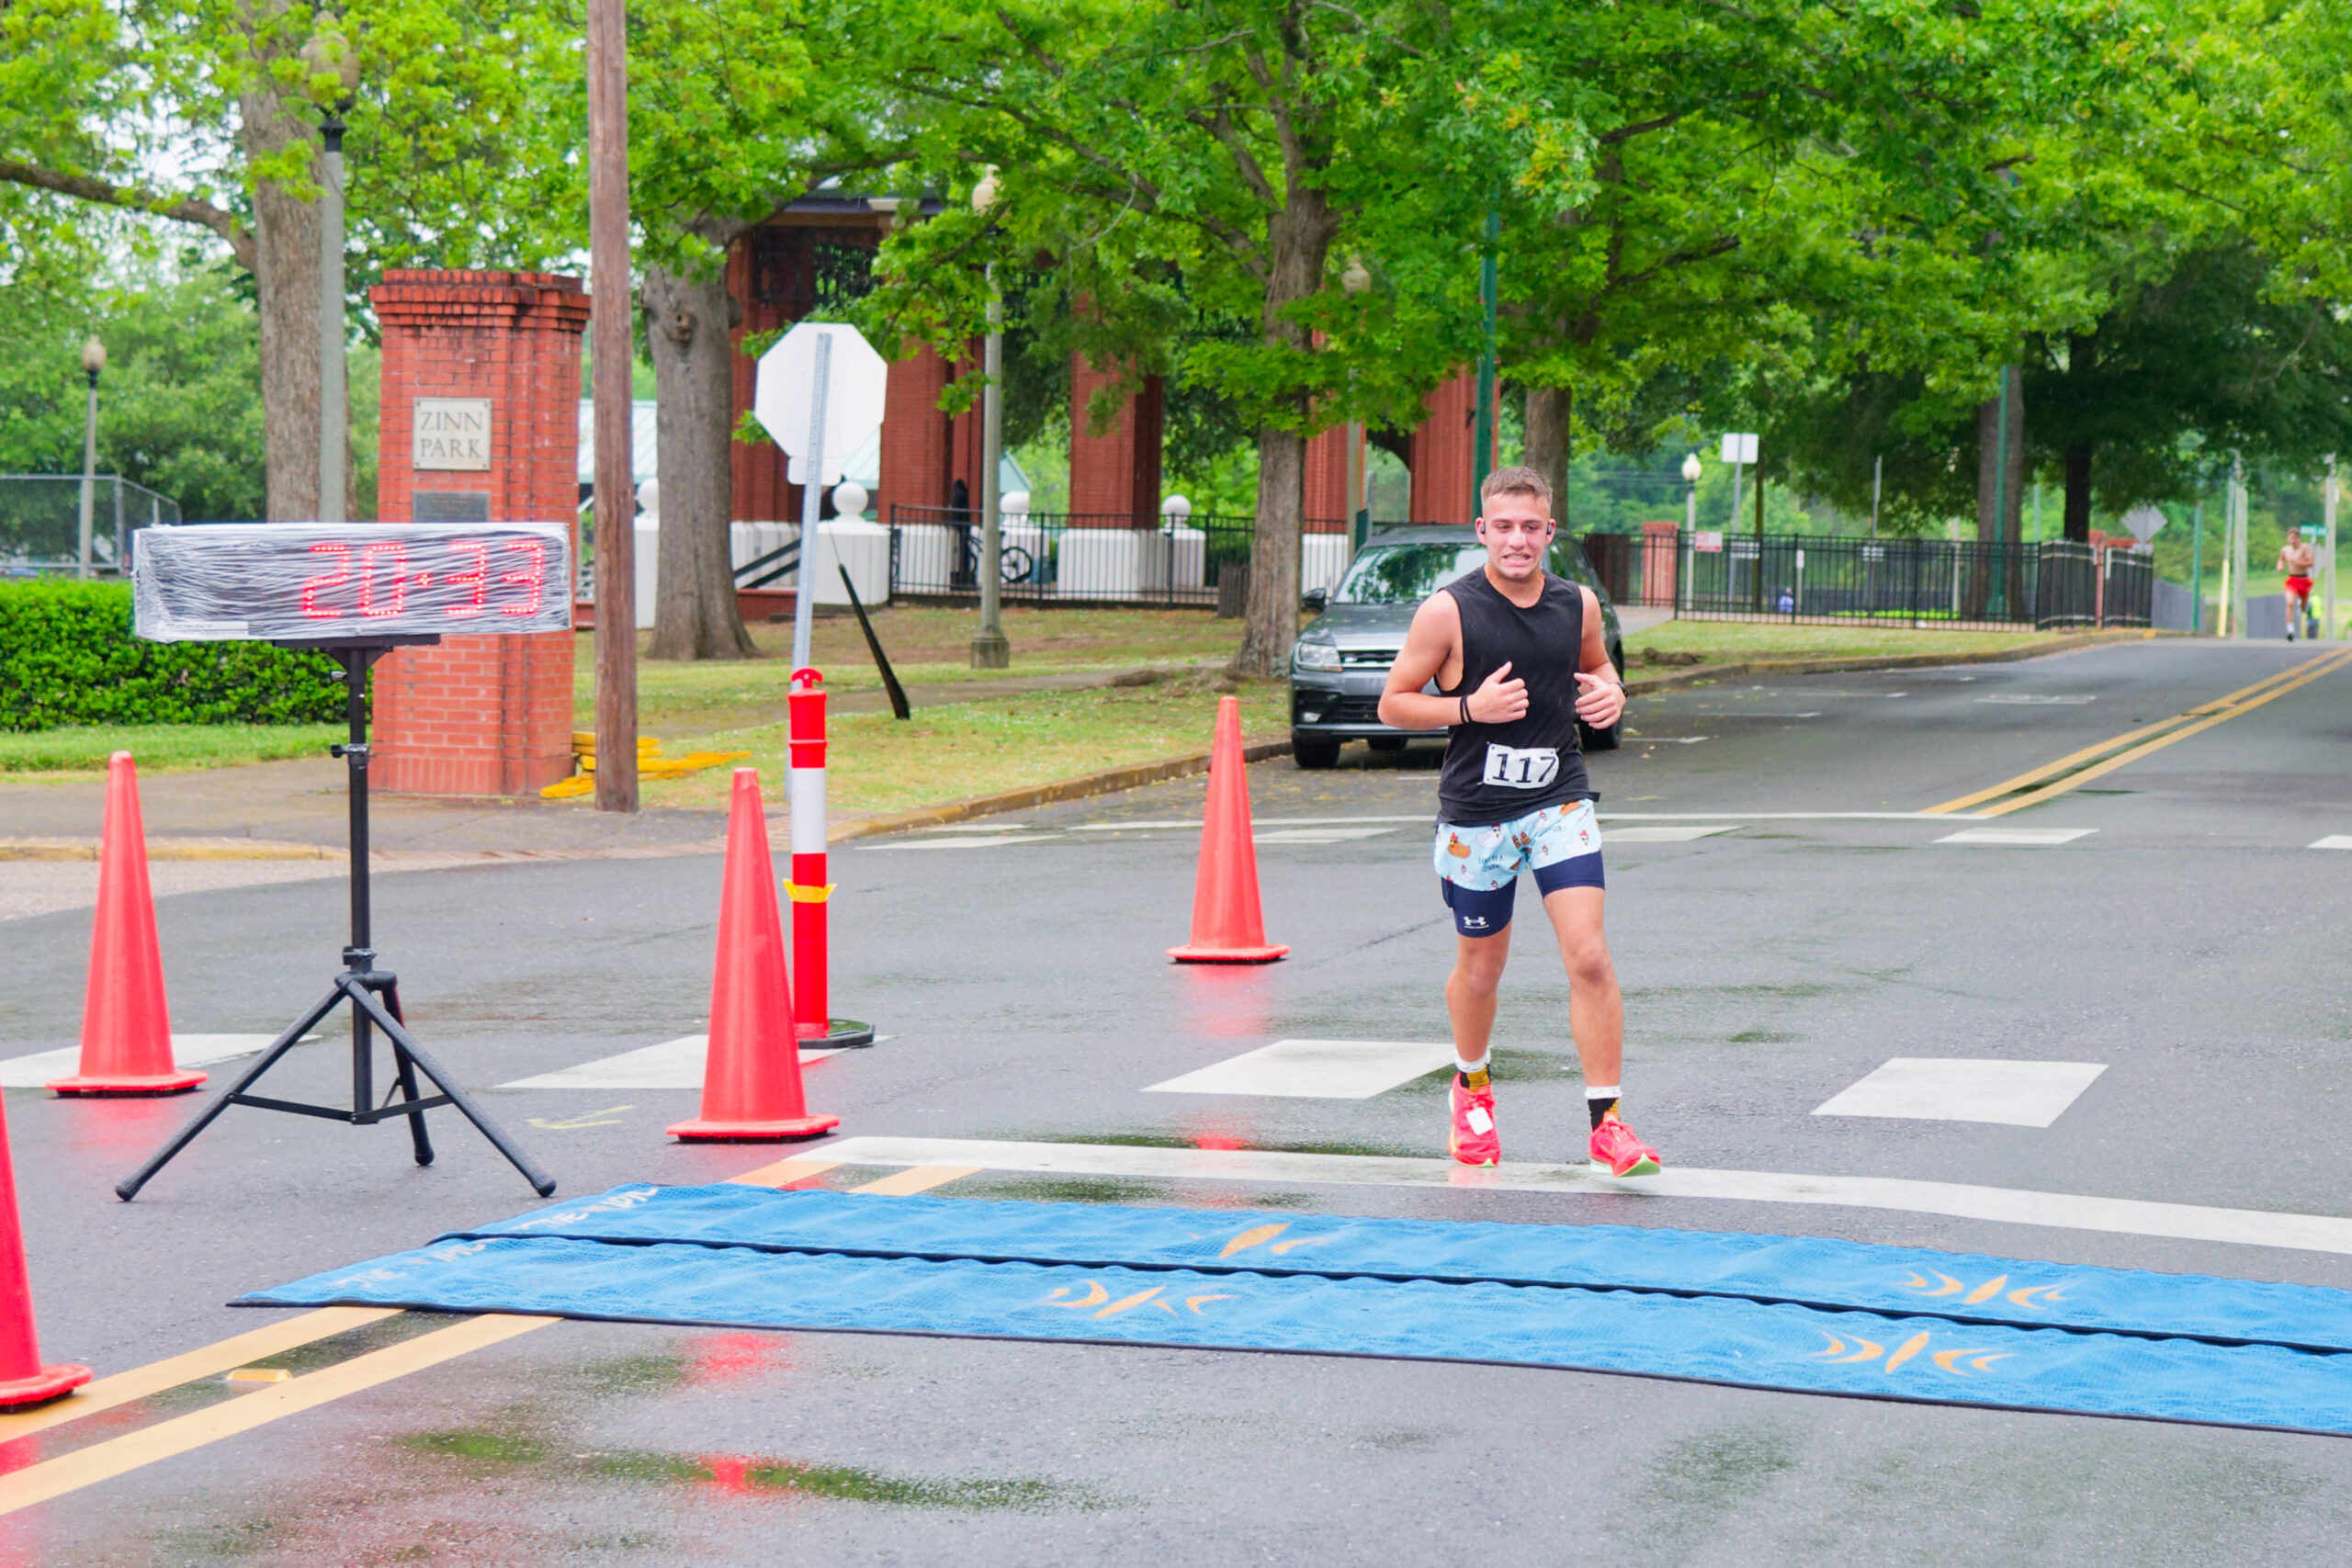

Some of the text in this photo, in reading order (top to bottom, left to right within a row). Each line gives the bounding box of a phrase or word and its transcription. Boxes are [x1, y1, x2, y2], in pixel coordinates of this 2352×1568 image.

[420, 411, 483, 432] ZINN
[420, 437, 484, 458] PARK
[1492, 753, 1556, 784] 117
